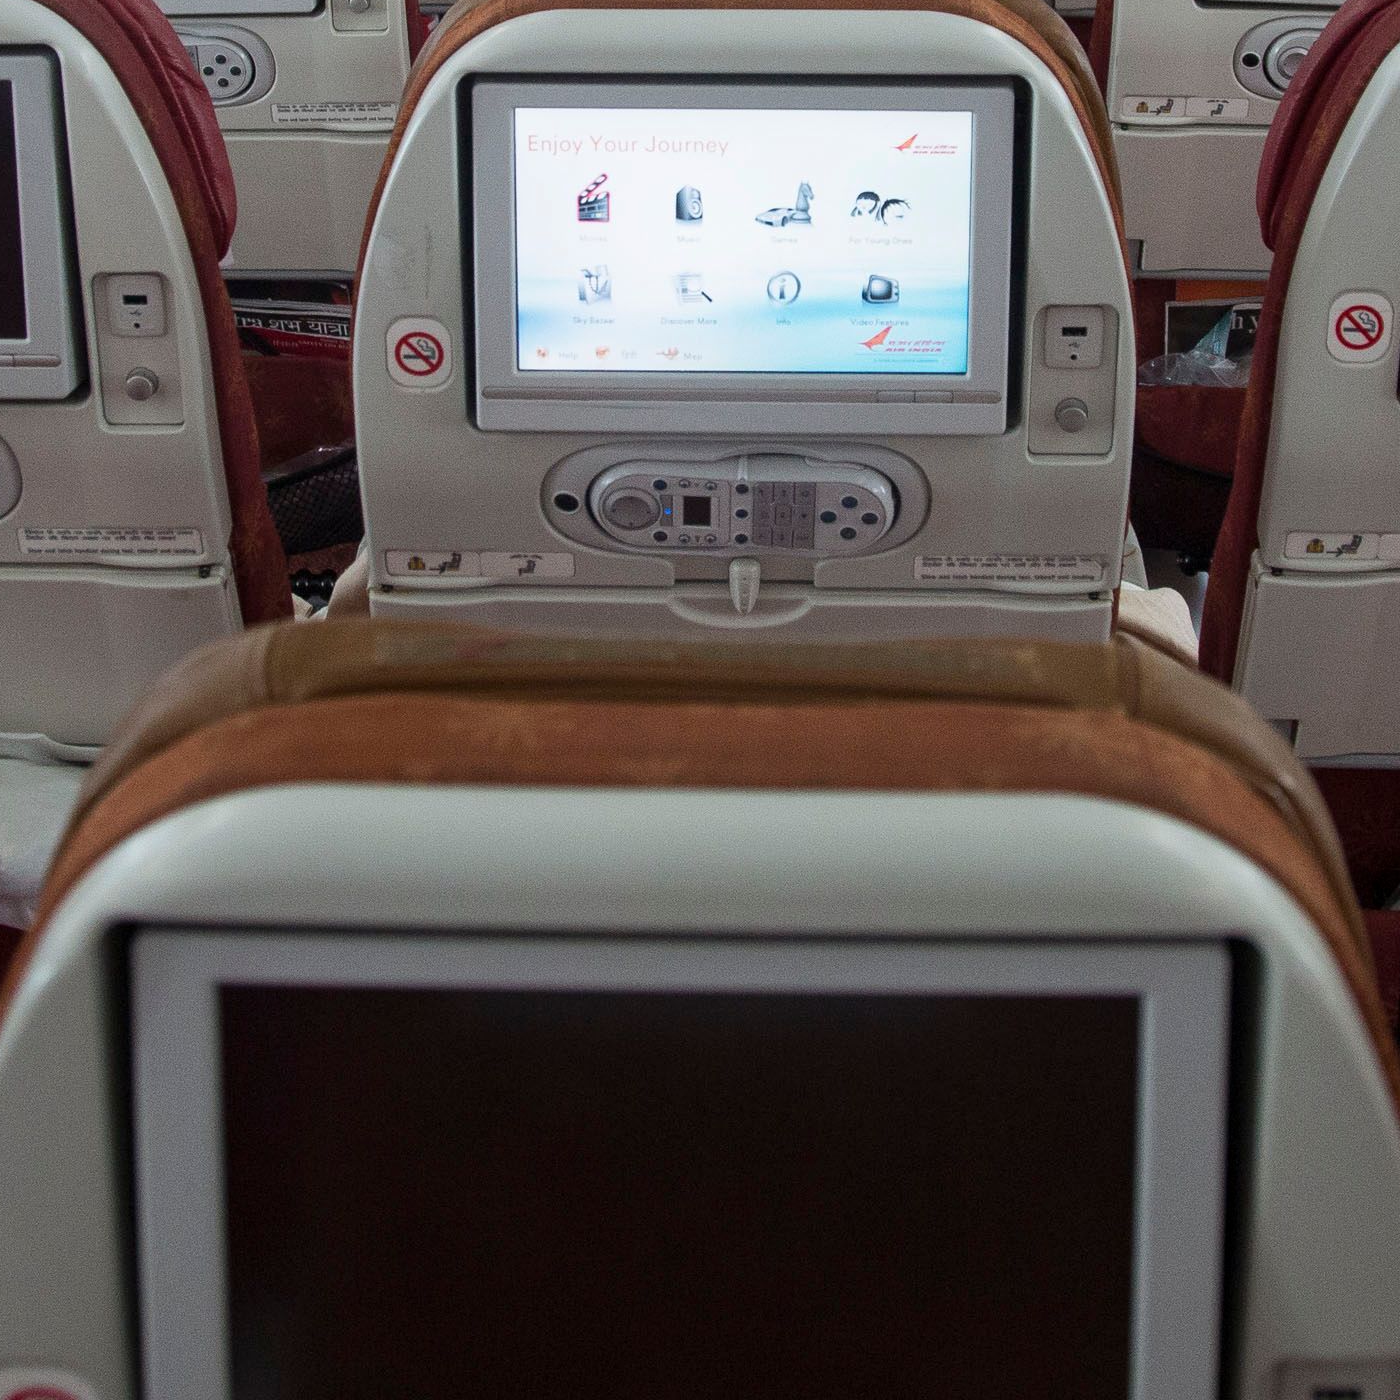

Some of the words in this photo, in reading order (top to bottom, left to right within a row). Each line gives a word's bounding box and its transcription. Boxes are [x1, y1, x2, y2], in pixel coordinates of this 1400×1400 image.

[527, 134, 583, 156] Enjoy
[589, 135, 638, 153] Your
[645, 135, 729, 157] Journey
[848, 236, 862, 245] For
[865, 236, 890, 246] Young
[893, 237, 913, 245] Ones
[573, 316, 587, 326] Sky
[660, 317, 696, 326] Discover
[697, 317, 718, 326] More
[850, 318, 874, 326] Video
[875, 319, 910, 327] Features
[306, 320, 349, 336] यात्रा
[558, 351, 578, 361] Help
